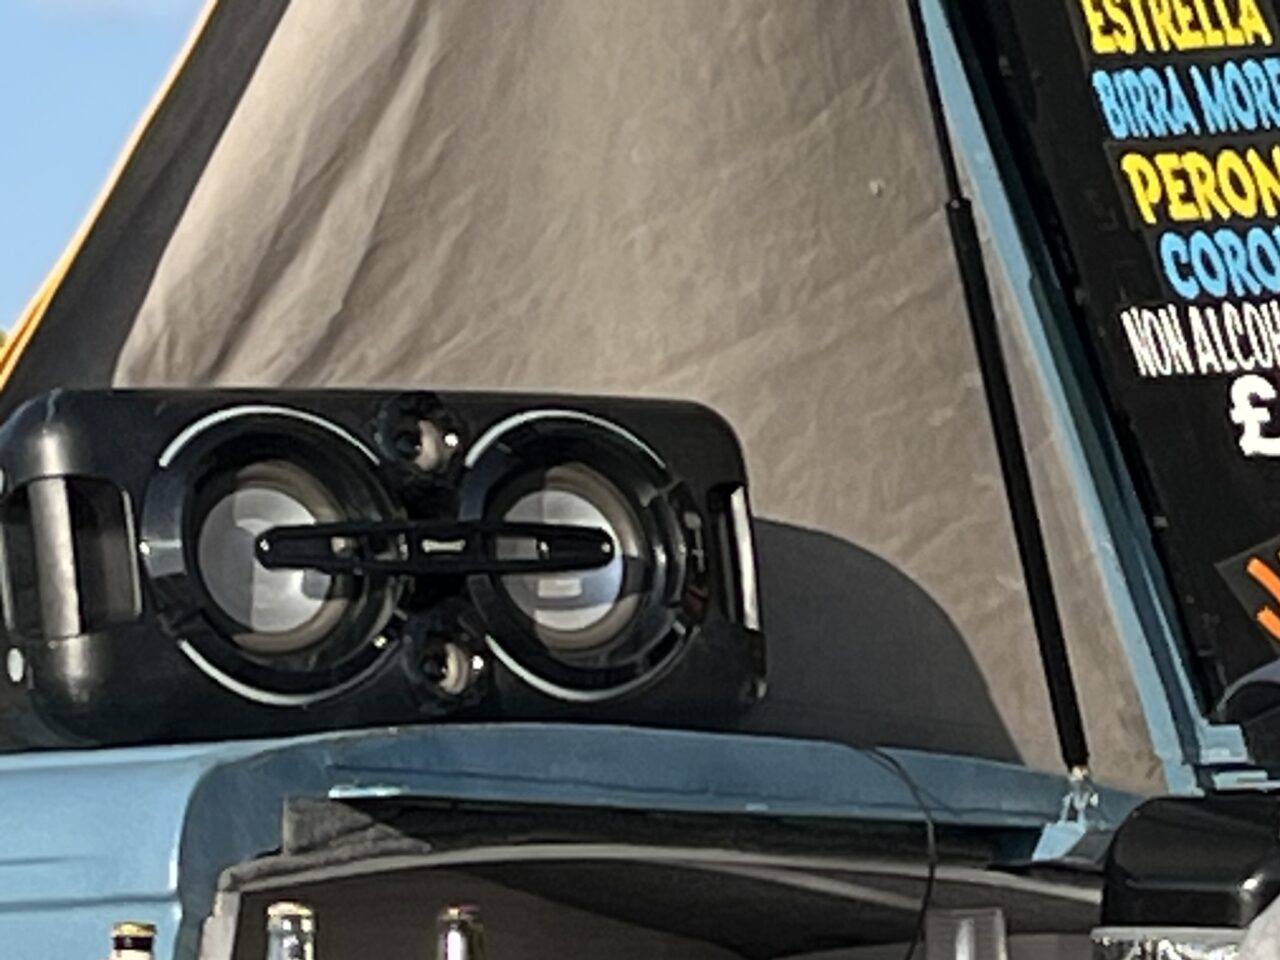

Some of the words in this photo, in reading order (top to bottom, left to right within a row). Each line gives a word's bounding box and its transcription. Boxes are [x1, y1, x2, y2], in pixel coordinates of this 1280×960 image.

[1081, 0, 1273, 54] ESTRELLA
[1092, 65, 1201, 140] BIRRA
[1120, 304, 1195, 378] NON
